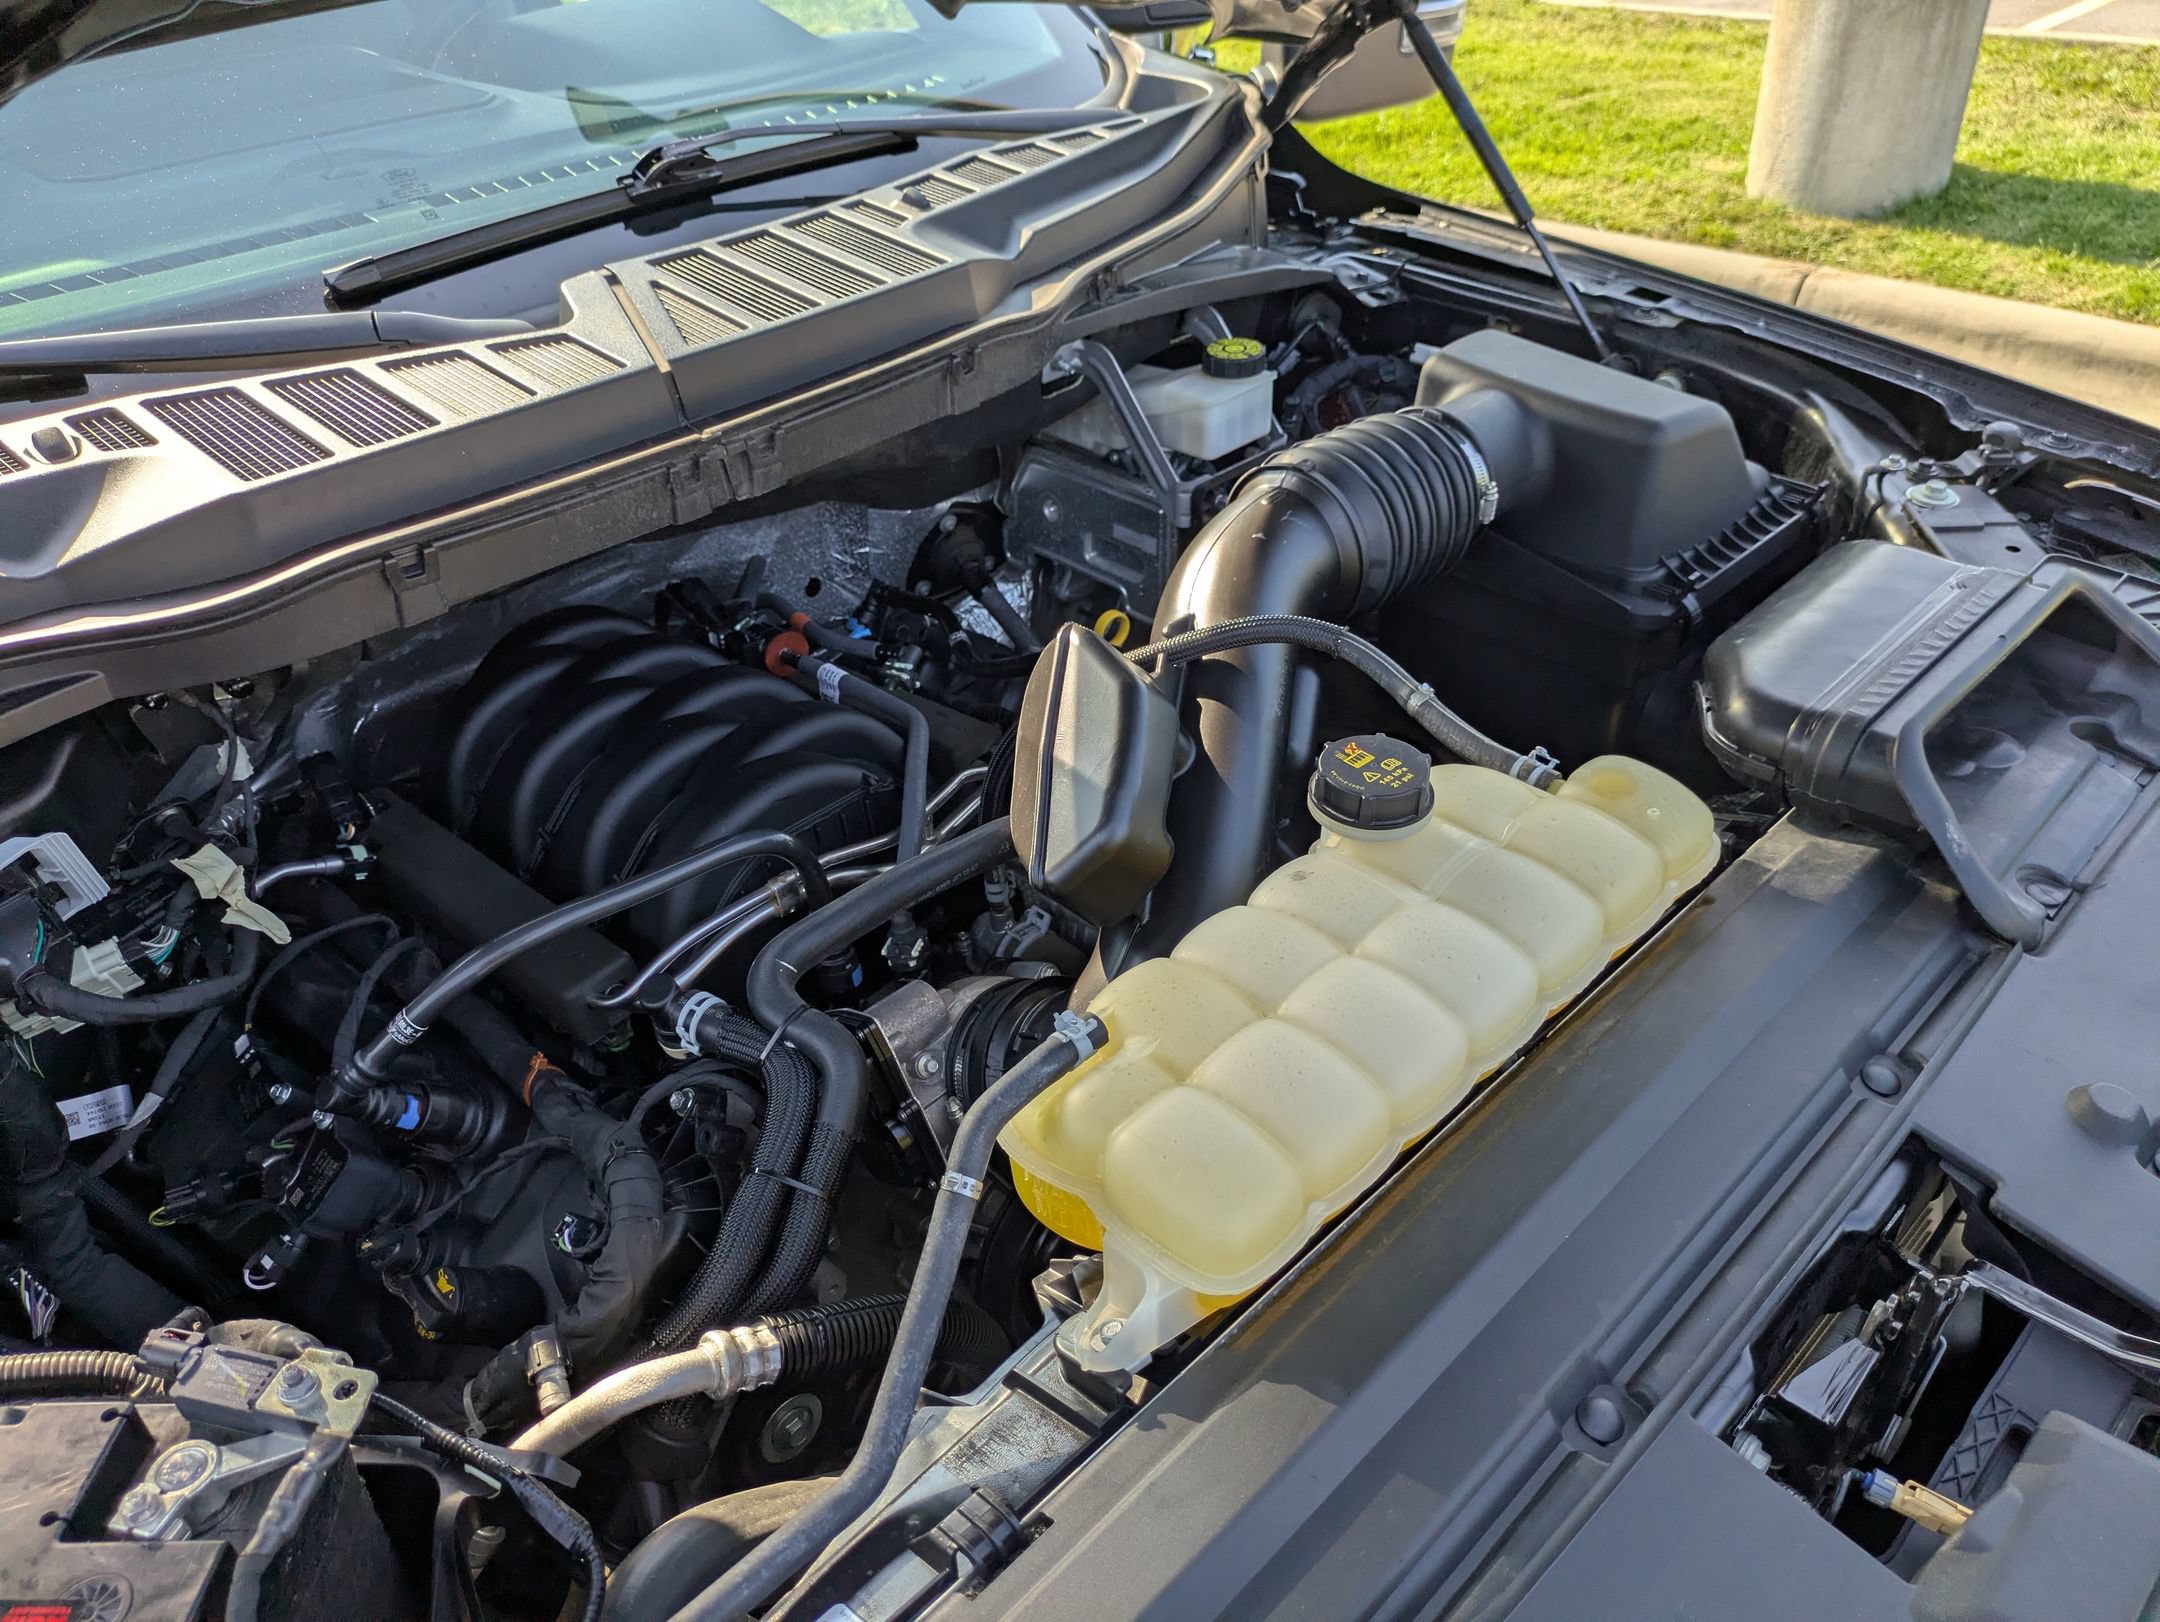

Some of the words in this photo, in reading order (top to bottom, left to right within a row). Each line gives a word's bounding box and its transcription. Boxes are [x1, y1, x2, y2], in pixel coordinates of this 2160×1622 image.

[1380, 774, 1394, 785] 145
[1393, 766, 1409, 777] kPa
[1391, 780, 1402, 788] 21
